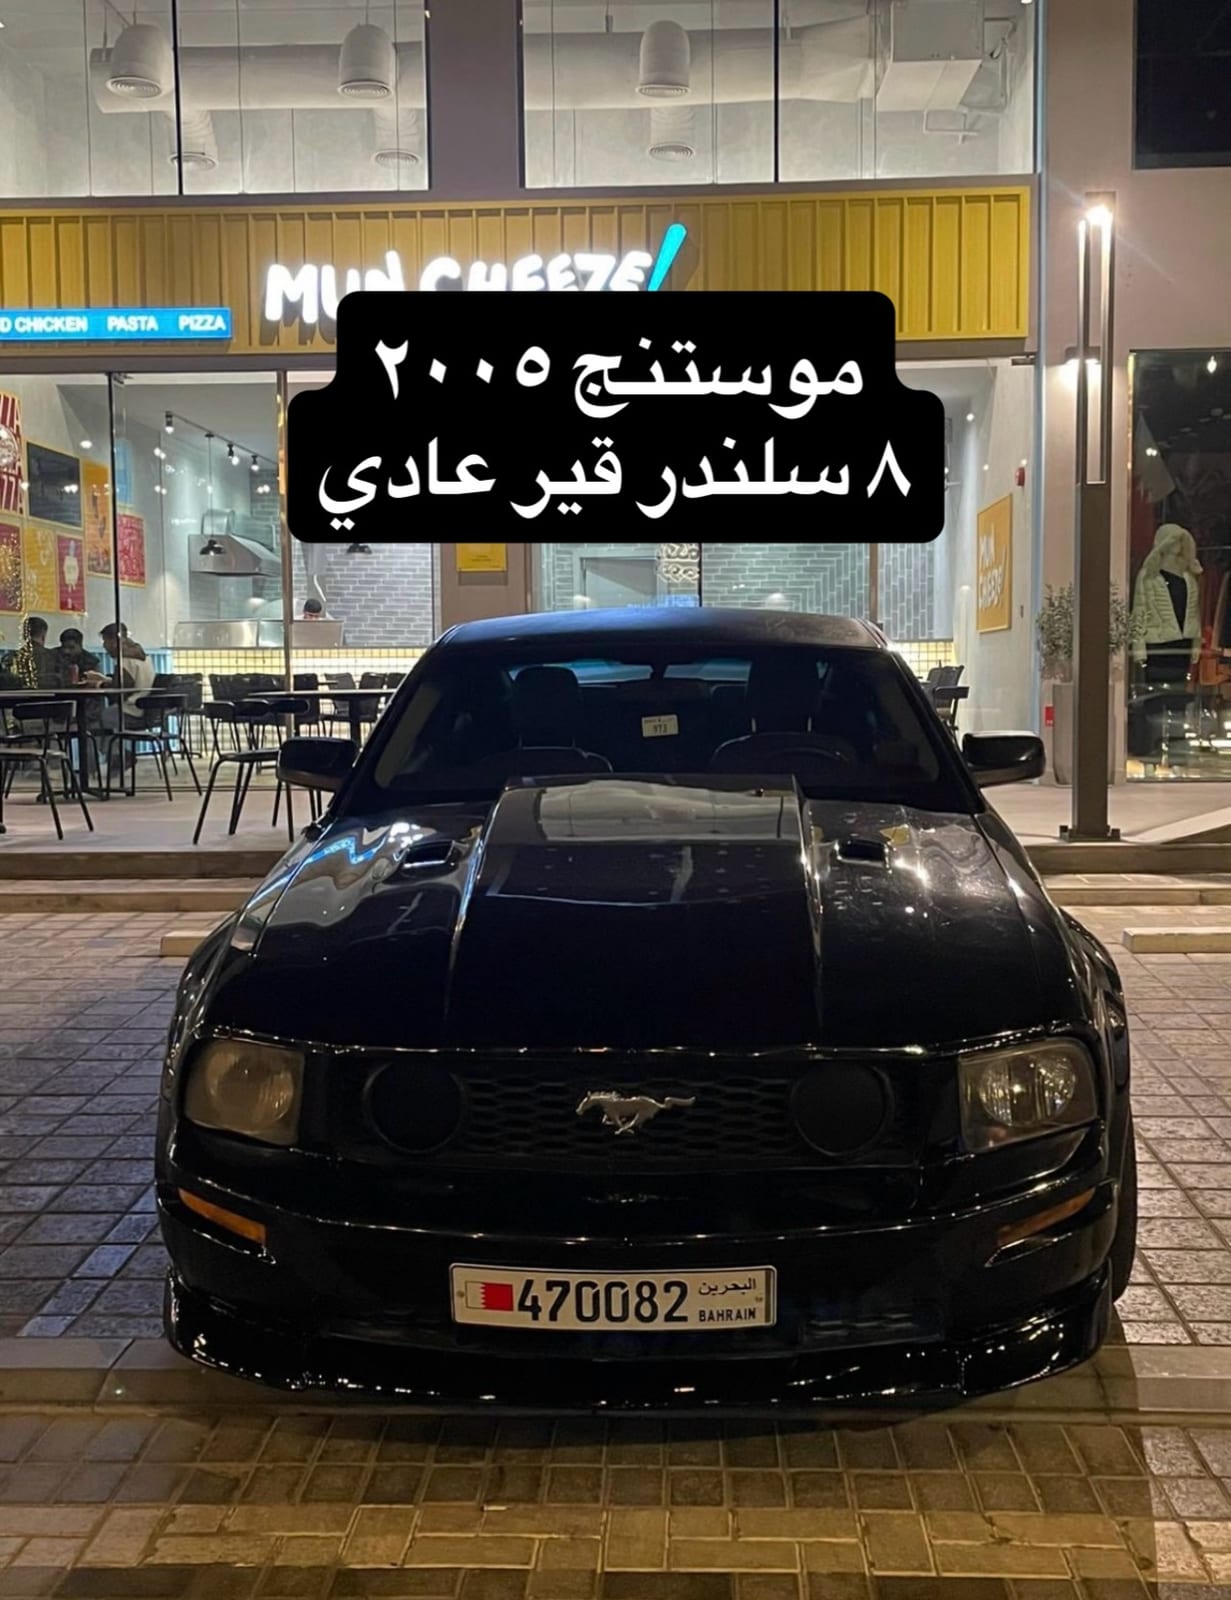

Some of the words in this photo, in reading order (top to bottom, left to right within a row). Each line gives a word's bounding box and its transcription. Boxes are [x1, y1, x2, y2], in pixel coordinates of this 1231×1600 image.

[15, 315, 88, 333] CHICKEN
[107, 314, 159, 332] PASTA
[178, 314, 227, 332] PIZZA
[698, 1277, 757, 1296] البحرين
[517, 1278, 689, 1324] 470082
[698, 1307, 757, 1322] BAHRAIN
